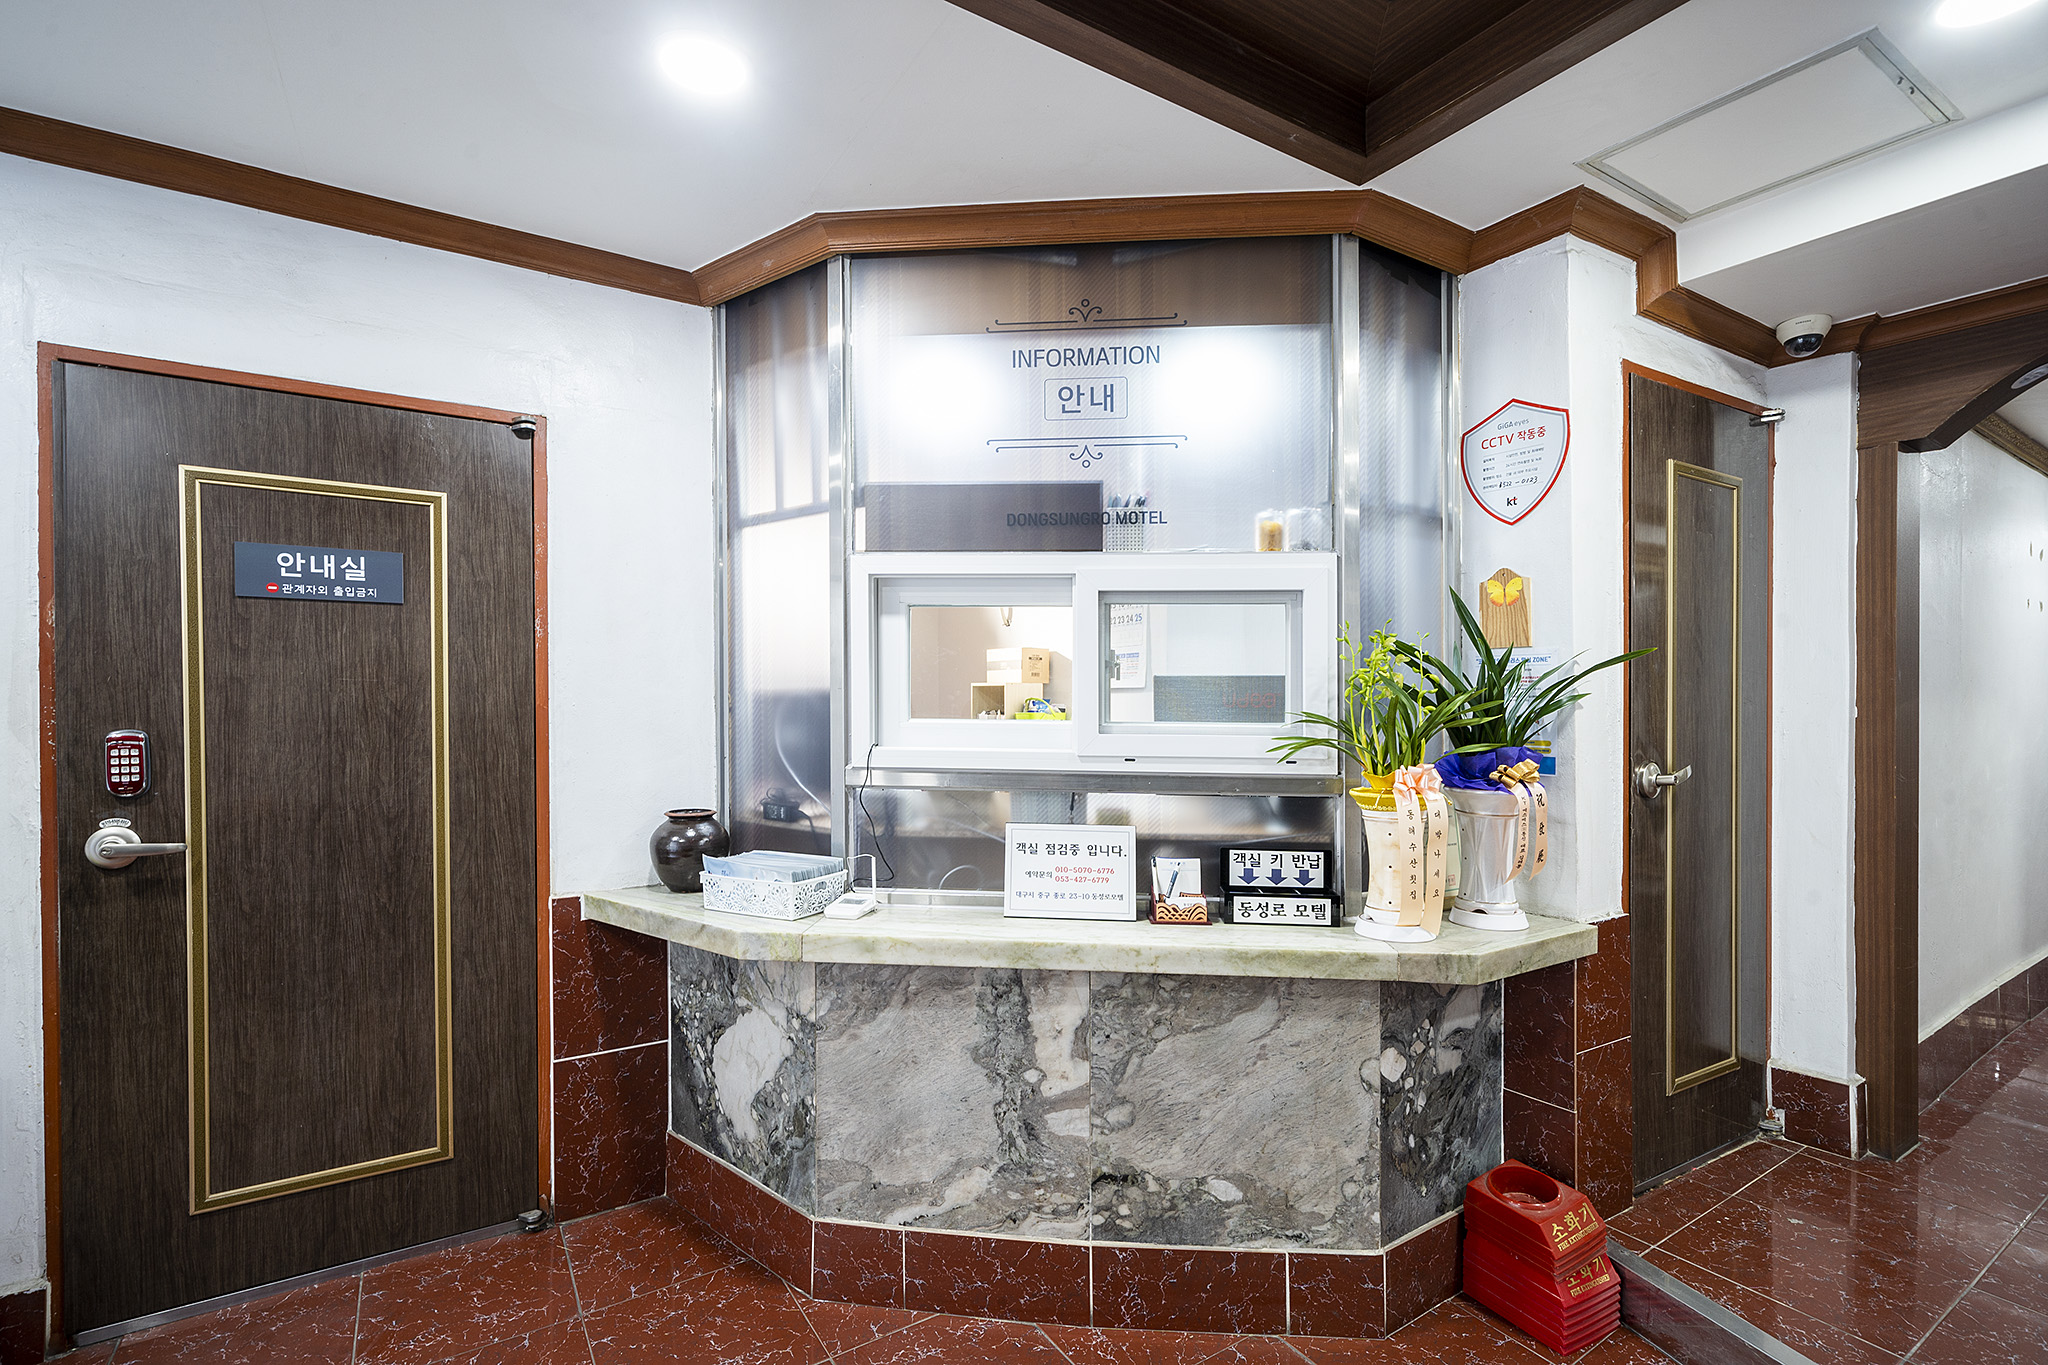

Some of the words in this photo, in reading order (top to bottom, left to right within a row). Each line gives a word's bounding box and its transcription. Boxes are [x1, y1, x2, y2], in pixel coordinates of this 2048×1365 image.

[1012, 345, 1160, 368] INFORMATION
[1058, 383, 1114, 414] 안내
[1481, 433, 1515, 450] CCTV
[1517, 425, 1546, 441] 작동중
[1506, 496, 1518, 507] kt
[1006, 511, 1111, 527] DONGSUNGRO
[1115, 510, 1168, 525] MOTEL
[276, 552, 366, 582] 안내실
[282, 583, 328, 596] 관계자외
[333, 586, 377, 598] 출입금지
[1118, 615, 1125, 624] 23
[1126, 614, 1133, 623] 24
[1134, 612, 1143, 622] 25
[1015, 842, 1038, 855] 객실
[1045, 843, 1080, 856] 점검중
[1087, 844, 1127, 857] 입니다.
[1233, 853, 1261, 868] 객실
[1270, 853, 1283, 869] 키
[1292, 854, 1321, 869] 반납
[1024, 870, 1053, 879] 예약문의
[1054, 866, 1115, 875] 010-5070-6776
[1054, 875, 1110, 884] 053-427-6779
[1238, 902, 1287, 918] 동성로
[1293, 903, 1326, 920] 모텔
[1551, 1202, 1596, 1242] 소화기
[1557, 1239, 1570, 1252] FIRE
